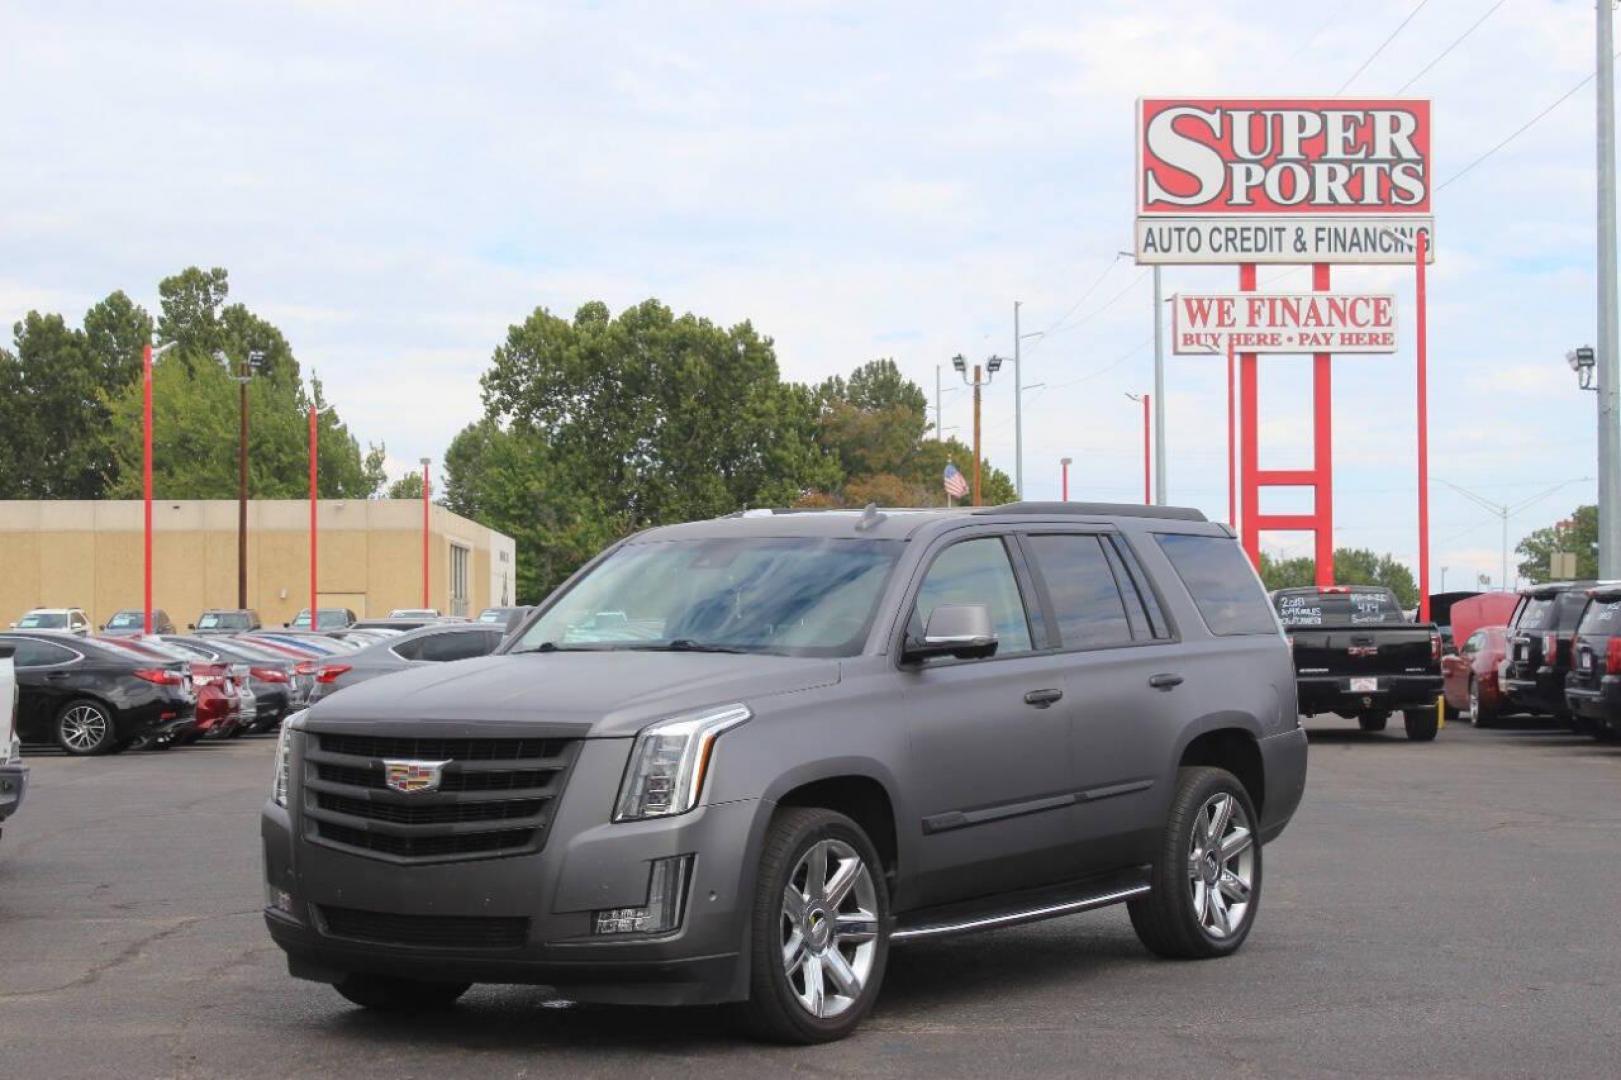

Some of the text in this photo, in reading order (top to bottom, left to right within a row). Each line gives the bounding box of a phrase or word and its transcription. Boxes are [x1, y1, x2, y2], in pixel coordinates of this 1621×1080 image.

[1143, 227, 1201, 253] AUTO
[1208, 227, 1286, 253] CREDIT
[1293, 227, 1307, 253] &
[1183, 296, 1393, 328] WE FINANCE
[1182, 333, 1394, 347] BUY HERE PAY HERE
